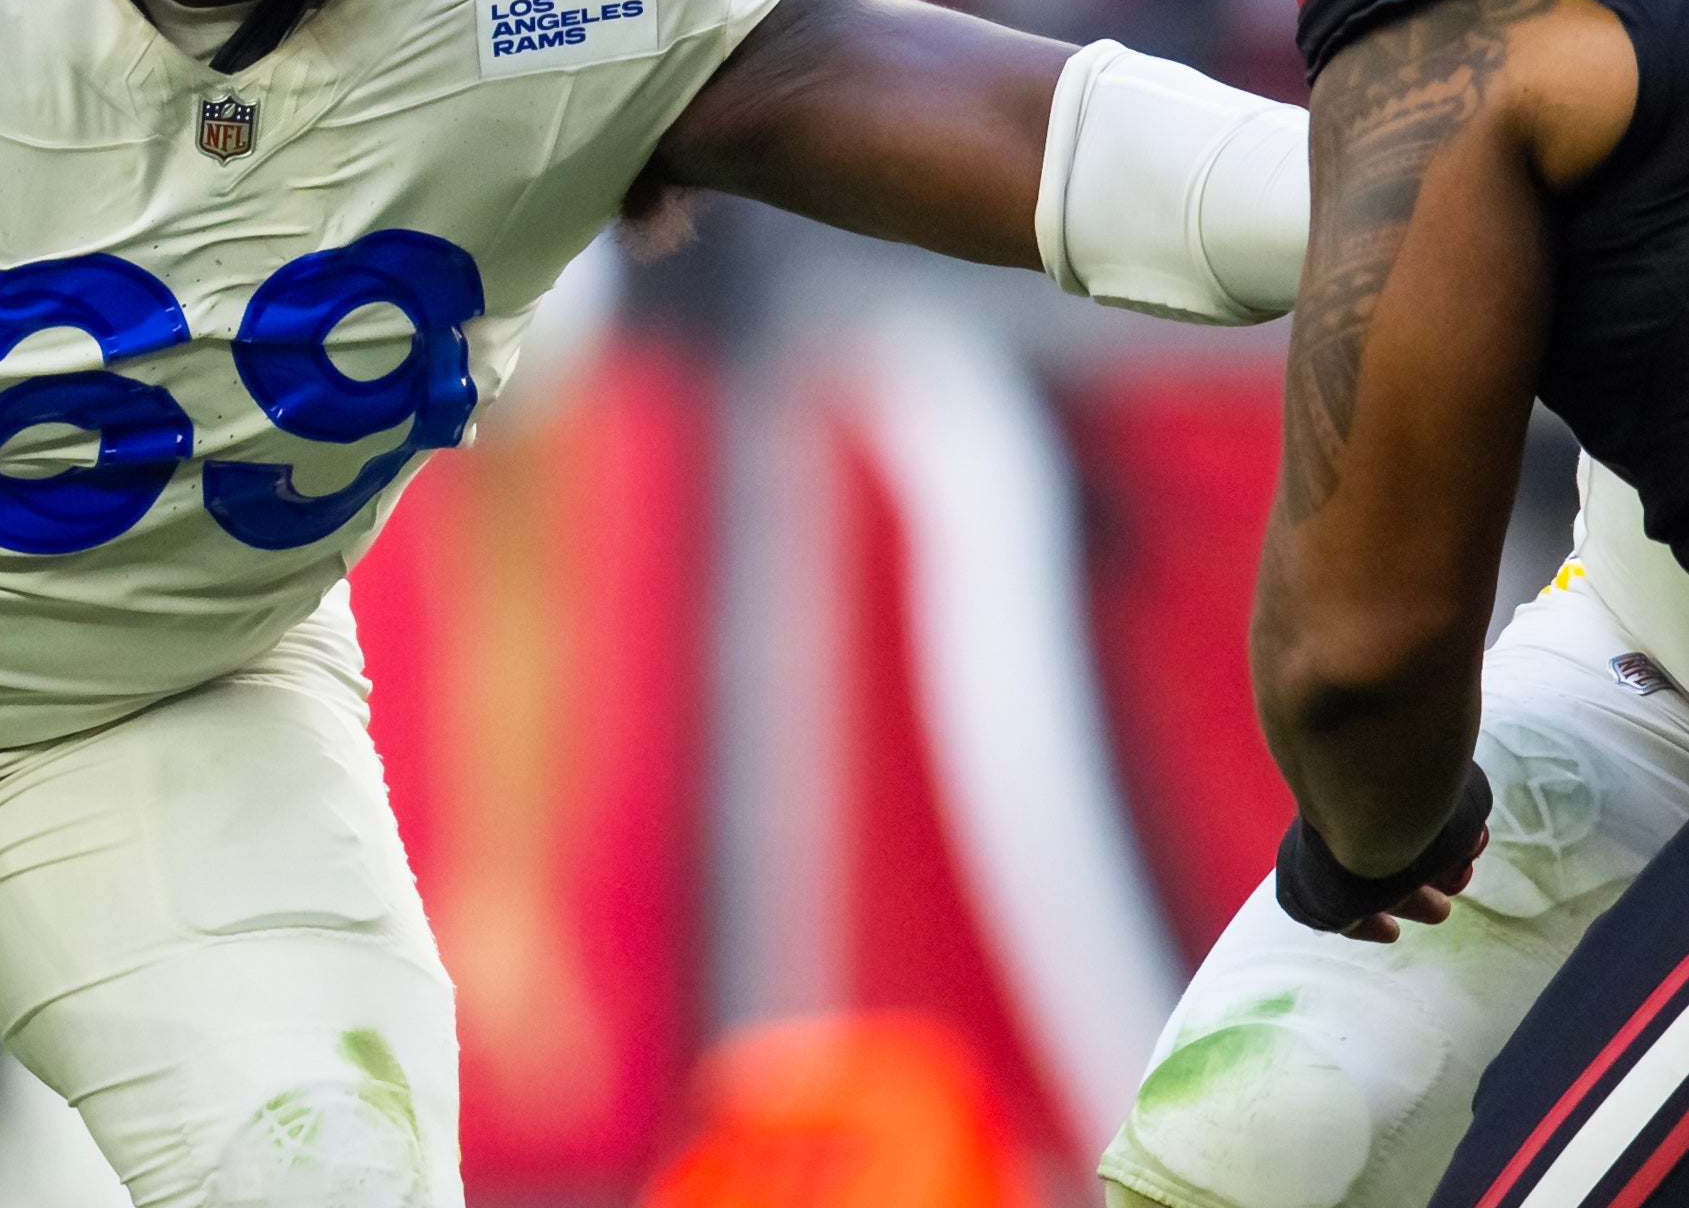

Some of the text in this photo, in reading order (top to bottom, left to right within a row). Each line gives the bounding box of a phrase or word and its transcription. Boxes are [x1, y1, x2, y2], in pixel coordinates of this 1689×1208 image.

[492, 0, 644, 39] ANGELES
[493, 27, 587, 57] RAMS
[202, 123, 247, 152] NFL
